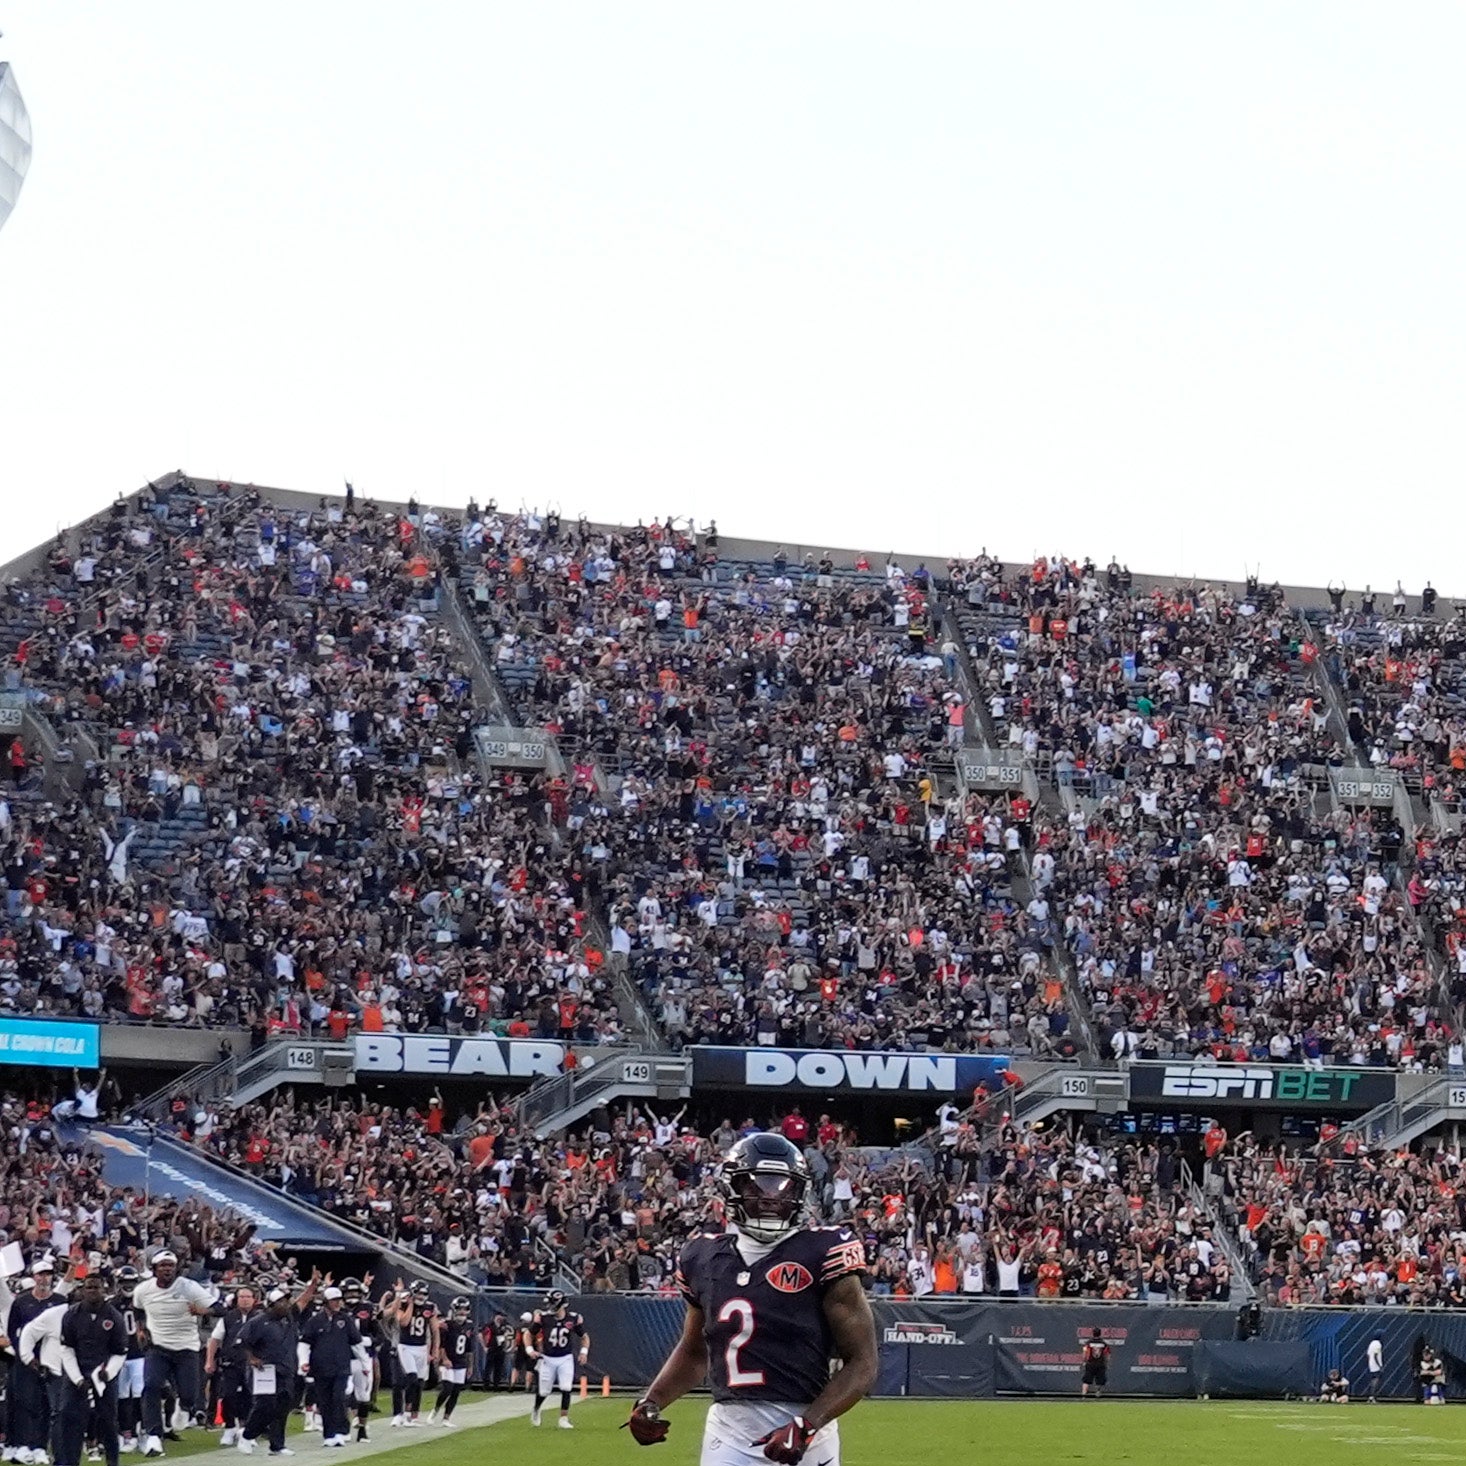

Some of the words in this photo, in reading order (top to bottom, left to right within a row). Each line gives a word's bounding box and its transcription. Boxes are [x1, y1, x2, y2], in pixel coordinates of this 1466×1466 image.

[289, 1050, 314, 1065] 148
[354, 1036, 566, 1077] BEAR
[624, 1064, 648, 1080] 149
[745, 1051, 956, 1092] DOWN
[1064, 1080, 1086, 1094] 150
[1162, 1067, 1274, 1099] ESPN
[1276, 1071, 1360, 1100] BET
[410, 1316, 424, 1338] 19
[456, 1334, 466, 1354] 8
[548, 1328, 570, 1348] 46
[717, 1297, 766, 1388] 2
